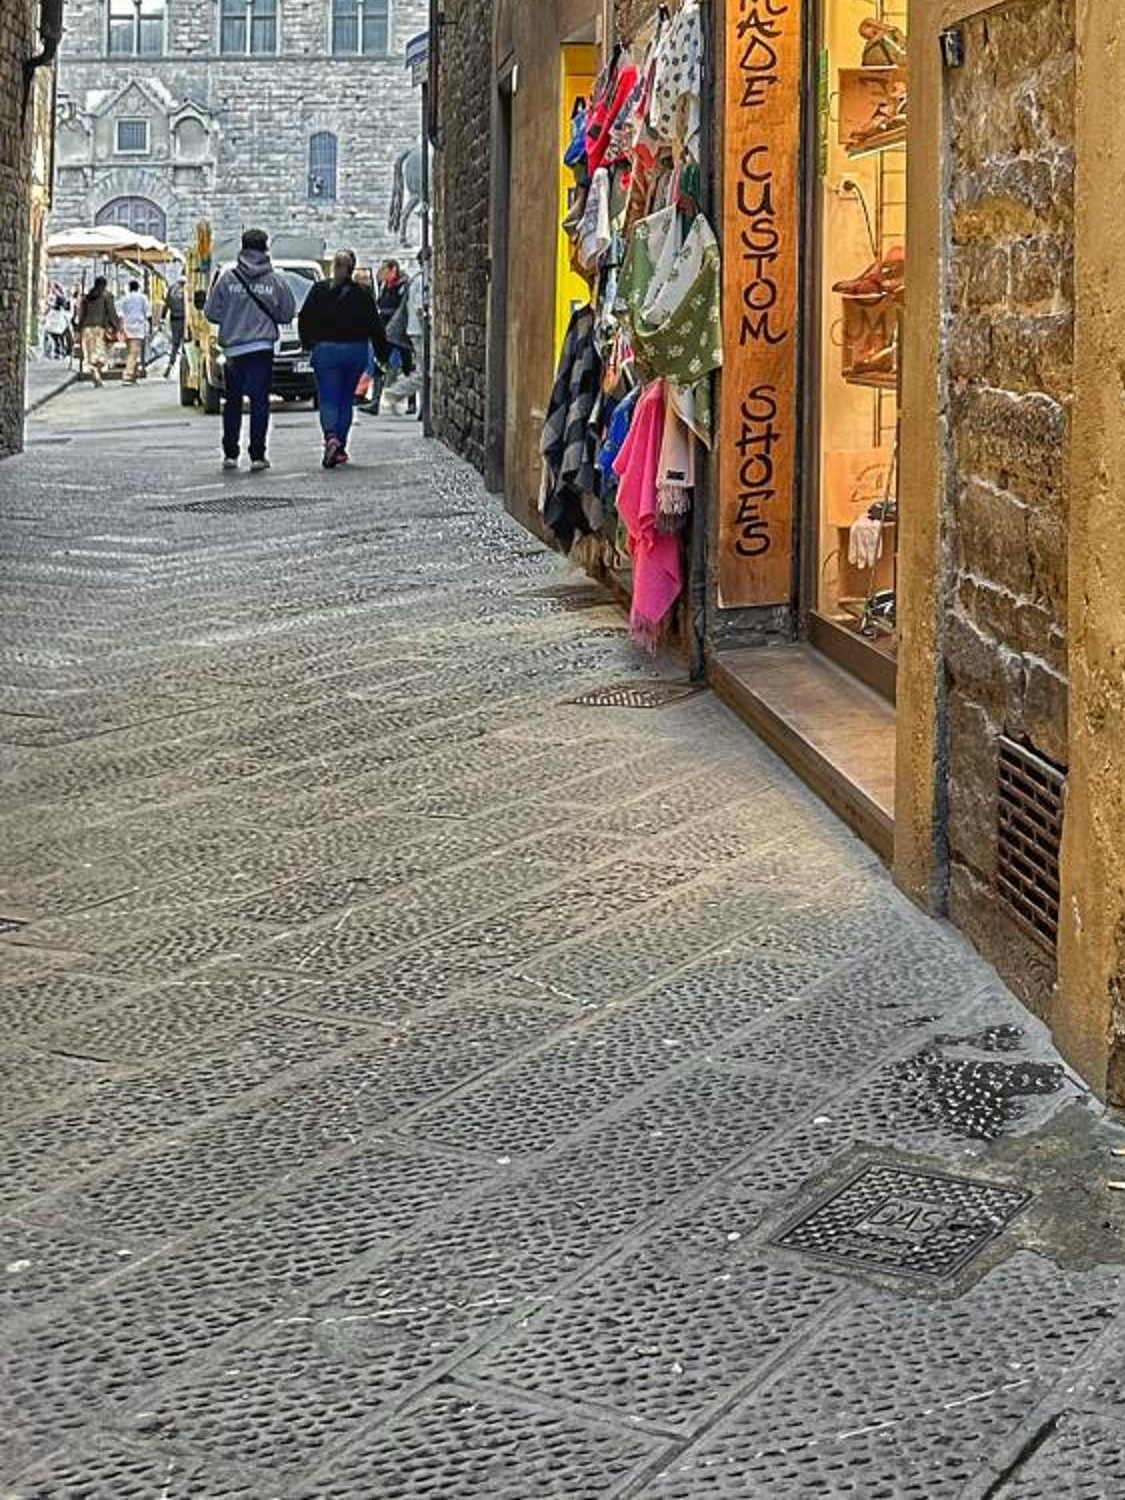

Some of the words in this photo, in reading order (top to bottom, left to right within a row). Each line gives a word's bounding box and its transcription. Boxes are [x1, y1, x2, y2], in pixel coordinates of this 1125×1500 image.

[737, 145, 788, 346] CUSTOM
[735, 384, 781, 556] SHOES
[868, 1201, 940, 1232] GAS
